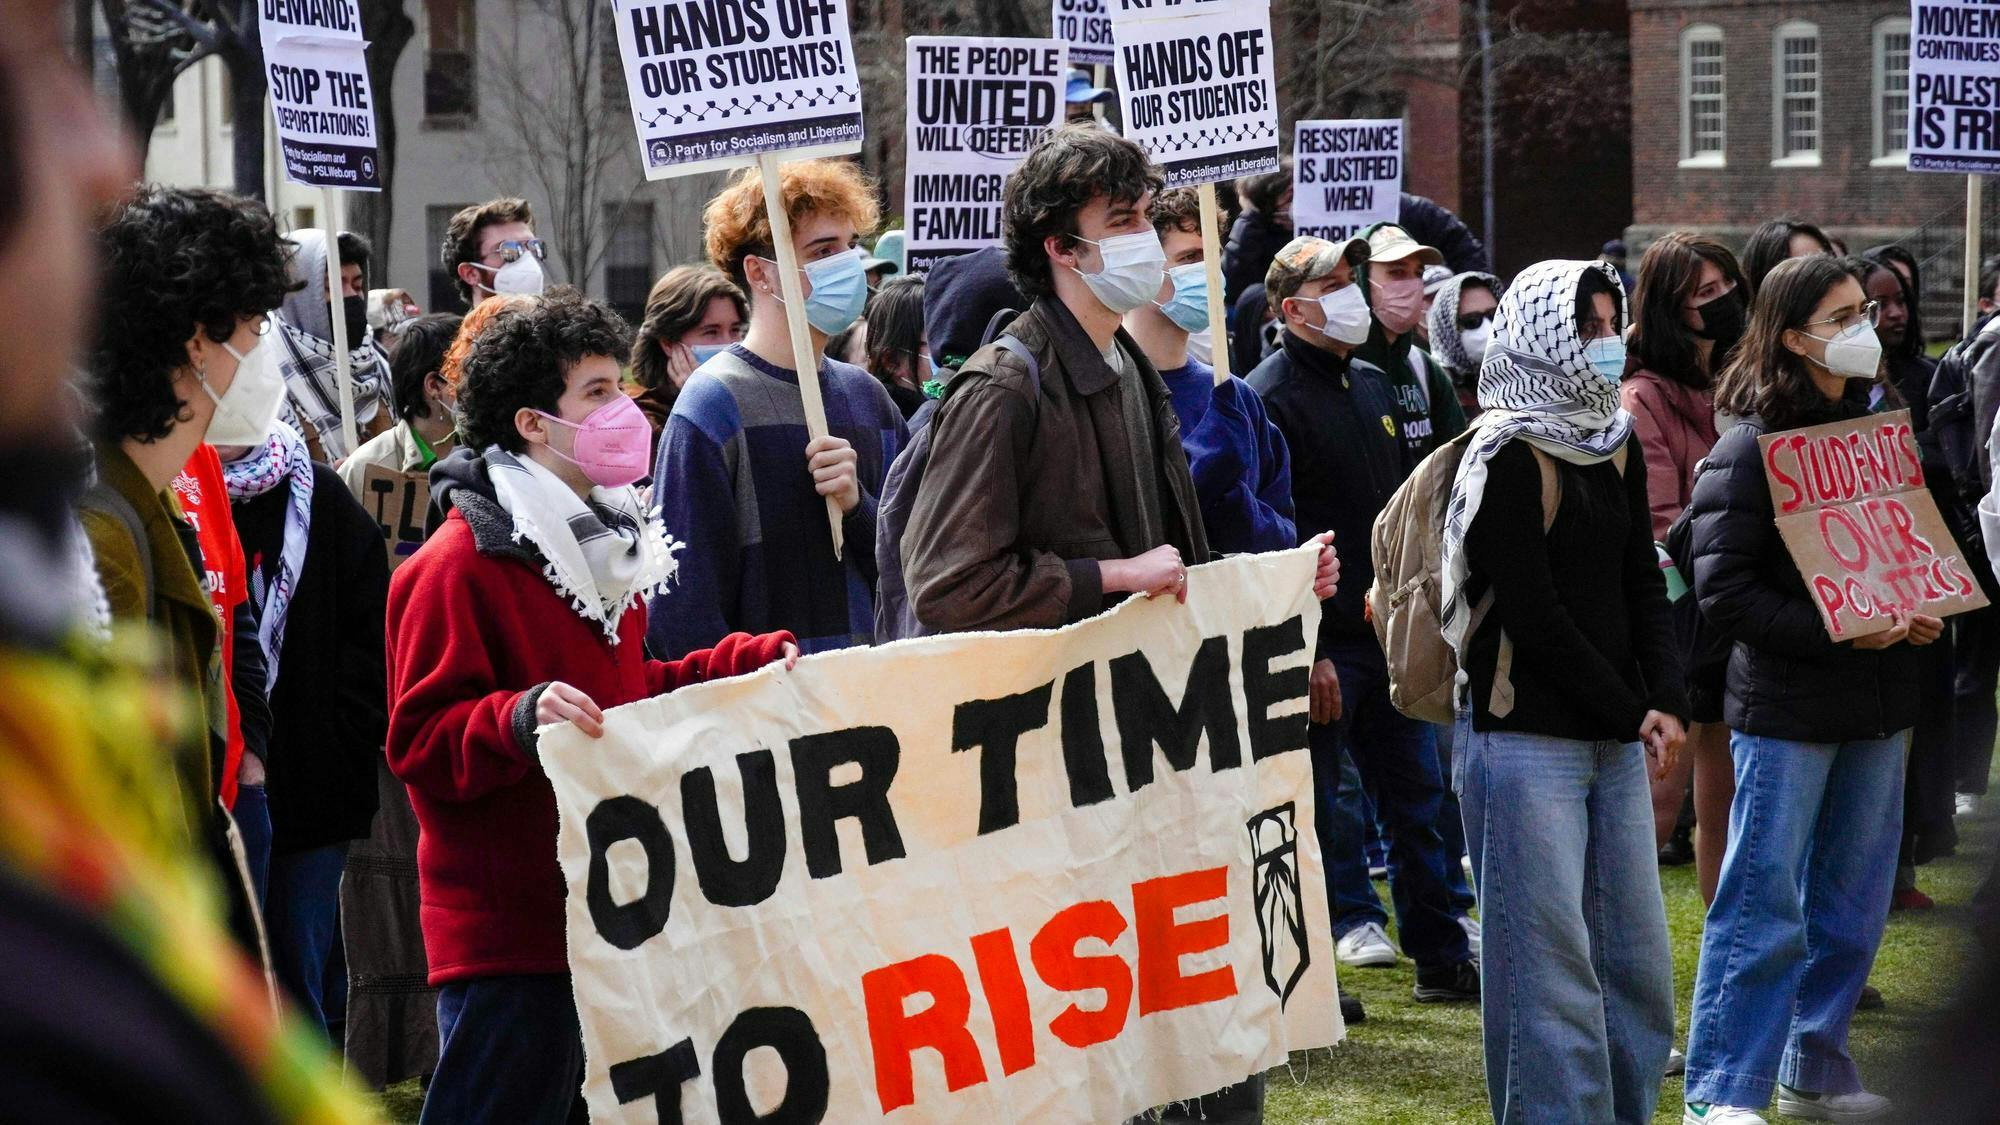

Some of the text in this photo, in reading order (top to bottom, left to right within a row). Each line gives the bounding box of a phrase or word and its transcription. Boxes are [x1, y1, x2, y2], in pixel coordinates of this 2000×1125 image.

[631, 0, 836, 57] HANDS OFF
[1058, 15, 1114, 45] TO ISR
[1918, 6, 2000, 38] MOVEM
[916, 46, 959, 74] THE
[967, 47, 1059, 76] PEOPLE
[1123, 29, 1264, 91] HANDS OFF
[1917, 40, 1999, 62] CONTINUES
[641, 40, 845, 98] OUR STUDENTS!
[271, 63, 367, 109] STOP THE
[917, 79, 1055, 125] UNITED
[1131, 79, 1268, 130] OUR STUDENTS!
[278, 106, 370, 137] DEPORTATIONS!
[1915, 107, 1945, 149] IS
[675, 123, 860, 157] Party for Socialism and Liberation
[916, 127, 963, 151] WILL
[1299, 126, 1398, 153] RESISTANCE
[302, 150, 332, 162] Socialism
[333, 153, 345, 164] and
[313, 165, 356, 181] PSLWeb.org
[1168, 170, 1178, 182] for
[1180, 166, 1220, 180] Socialism
[1221, 161, 1234, 174] and
[1236, 156, 1275, 171] Liberation
[1299, 156, 1397, 183] IS JUSTIFIED
[914, 174, 1004, 203] IMMIGR
[1324, 186, 1373, 212] WHEN
[1767, 424, 1924, 513] STUDENTS
[1819, 499, 1934, 572] OVER
[1813, 557, 1974, 635] POLITICS
[586, 615, 1309, 950] OUR TIME
[609, 865, 1238, 1125] TO RISE
